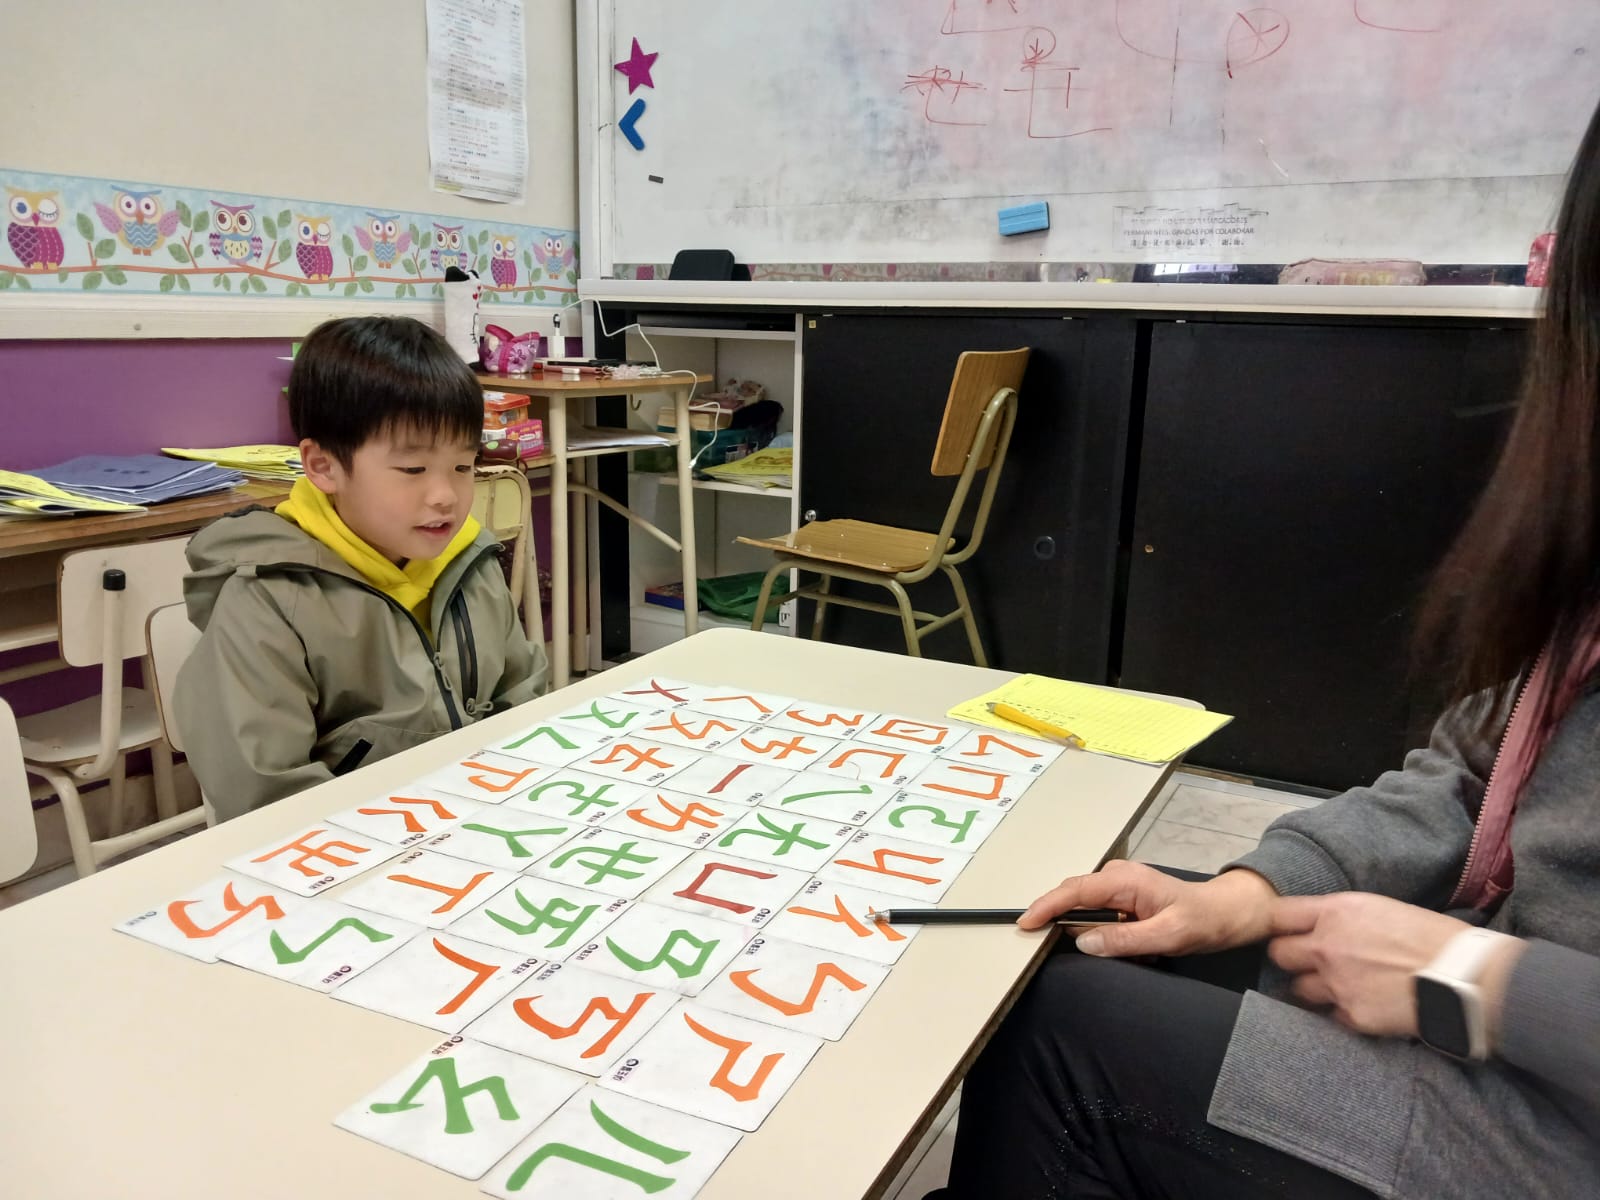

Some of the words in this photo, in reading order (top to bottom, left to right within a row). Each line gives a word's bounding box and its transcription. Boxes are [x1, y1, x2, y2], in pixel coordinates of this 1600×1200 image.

[559, 700, 639, 728] ㄡ
[704, 695, 772, 713] ㄑ
[787, 710, 863, 727] ㄋ
[501, 726, 580, 750] ㄥ
[644, 711, 737, 739] ㄆ
[872, 719, 948, 745] ㄖ
[590, 743, 674, 772] ㄊ
[741, 736, 817, 759] ㄘ
[829, 749, 907, 778] ㄈ
[960, 735, 1041, 757] ㄙ
[460, 761, 539, 792] ㄗ
[922, 766, 1009, 800] ㄇ
[357, 796, 458, 832] ㄍ
[527, 780, 619, 816] ㄜ
[627, 794, 724, 832] ㄌ
[719, 813, 830, 856] ㄤ
[889, 806, 980, 843] ㄛ
[250, 829, 370, 877] ㄓ
[550, 841, 658, 885] ㄝ
[834, 849, 944, 885] ㄐ
[386, 871, 494, 914] ㄒ
[673, 862, 777, 915] ㄩ
[167, 881, 286, 939] ㄉ
[485, 887, 600, 949] ㄞ
[269, 917, 394, 965] ㄣ
[606, 929, 720, 979] ㄢ
[432, 937, 501, 1015] ㄏ
[730, 963, 866, 1016] ㄅ
[513, 992, 655, 1059] ㄎ
[684, 1013, 784, 1102] ㄕ
[369, 1056, 520, 1134] ㄠ
[505, 1099, 691, 1193] ㄦ
